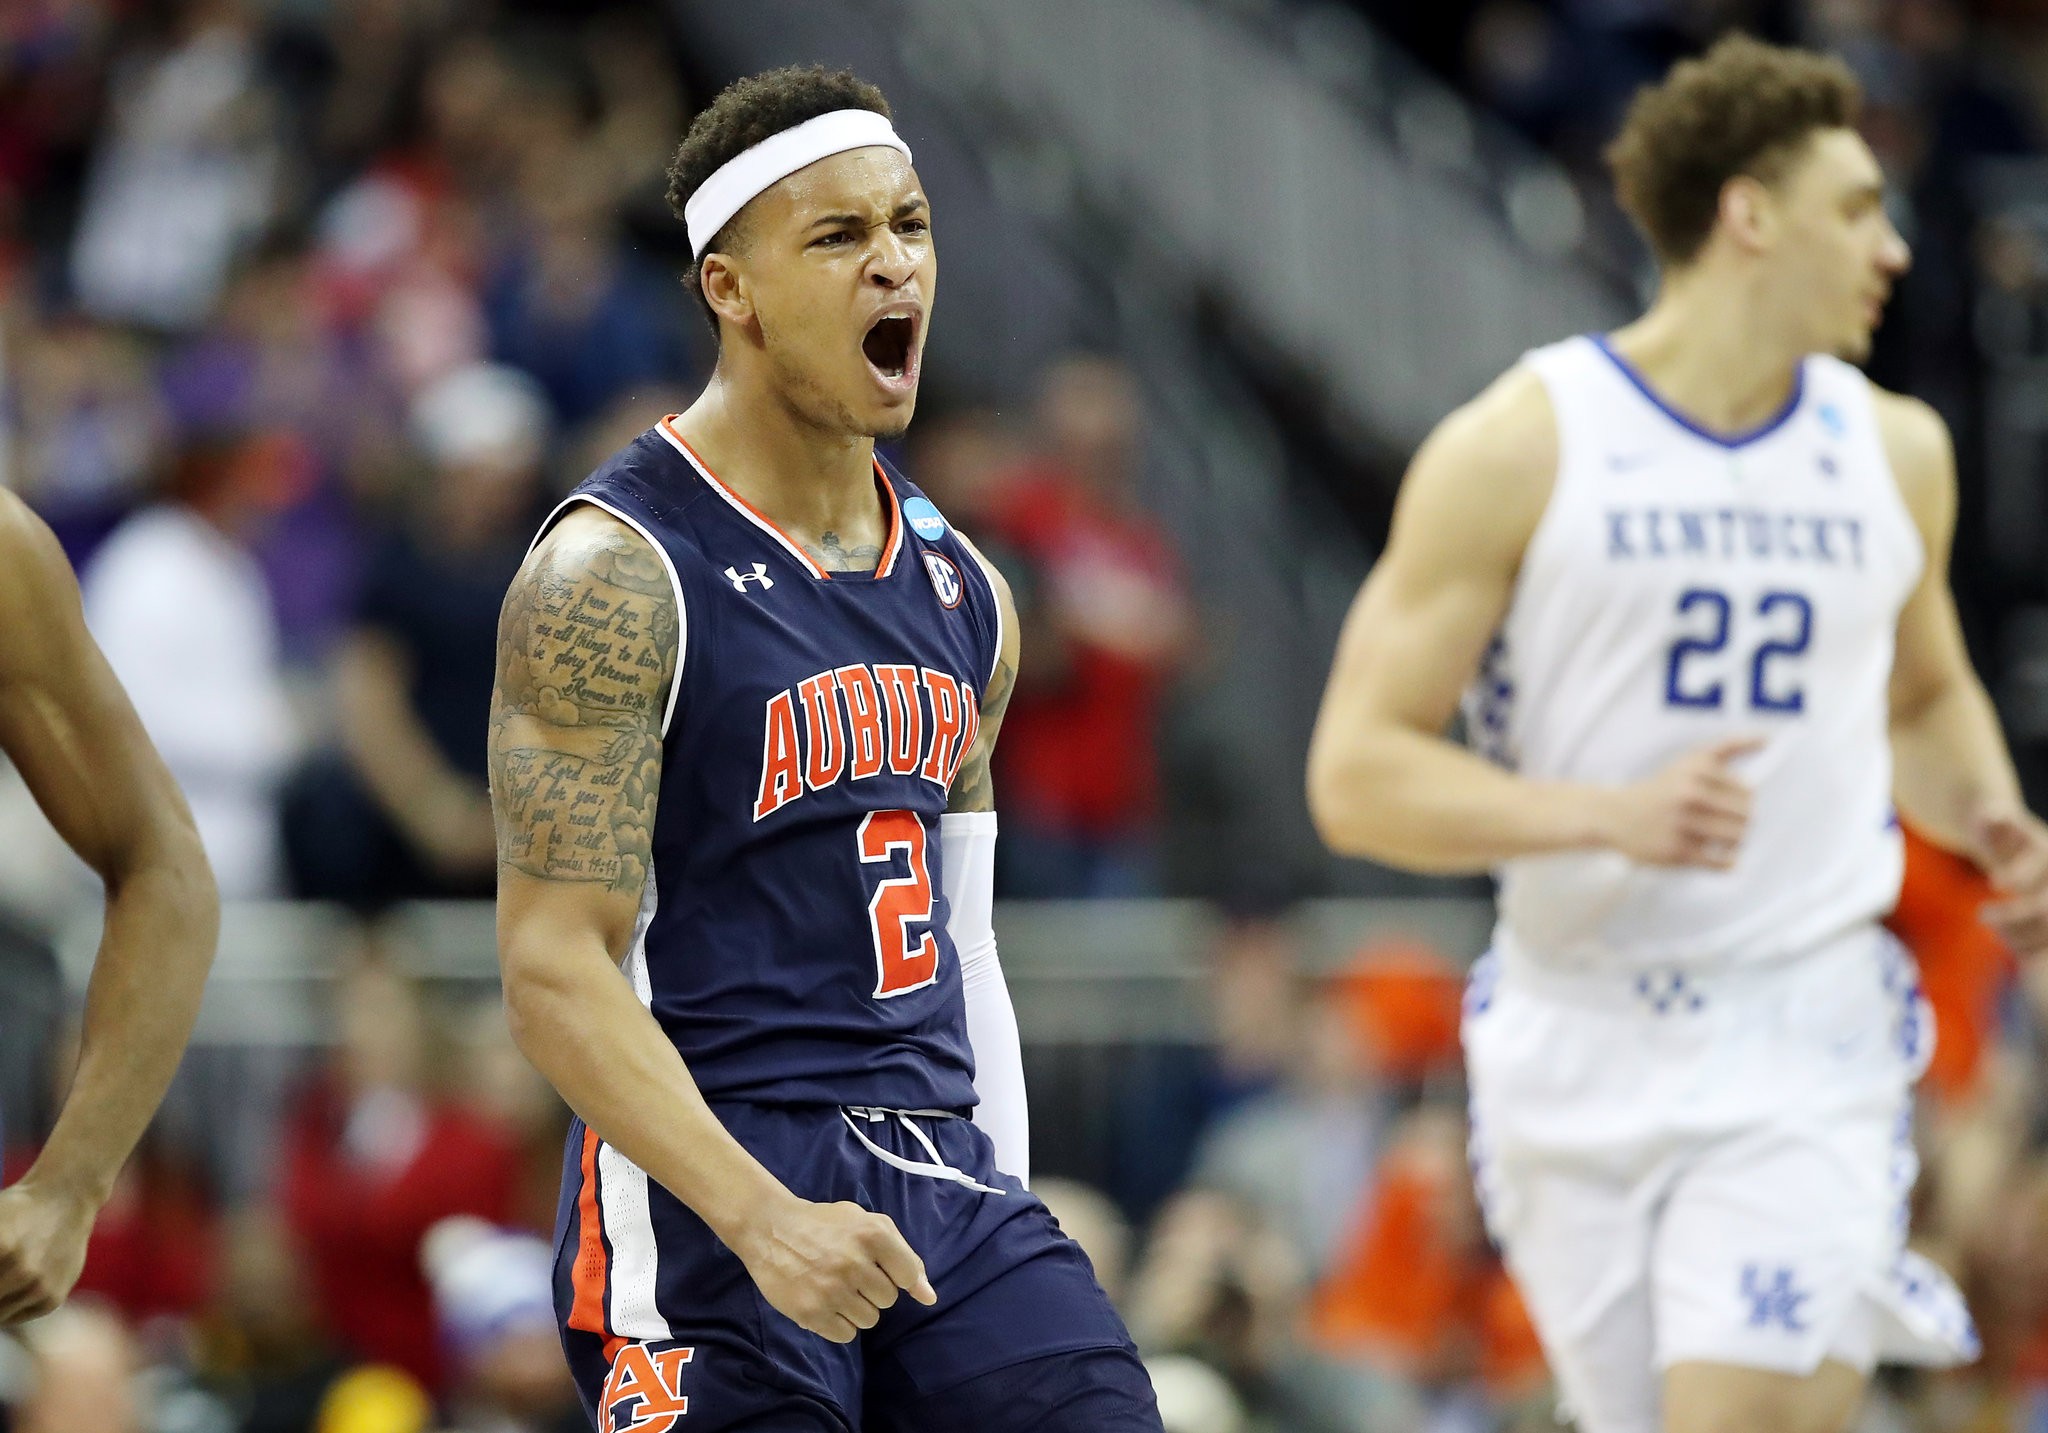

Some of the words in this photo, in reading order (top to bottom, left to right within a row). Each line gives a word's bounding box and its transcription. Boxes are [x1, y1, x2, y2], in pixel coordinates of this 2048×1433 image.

[912, 517, 943, 530] NCAA
[1606, 508, 1863, 570] KENTUCKY
[923, 554, 959, 604] EC
[617, 645, 632, 662] to
[634, 647, 660, 672] him
[1664, 588, 1814, 714] 22
[590, 657, 641, 686] forever
[539, 757, 586, 782] Lord
[590, 767, 624, 786] will
[856, 808, 940, 1000] 2
